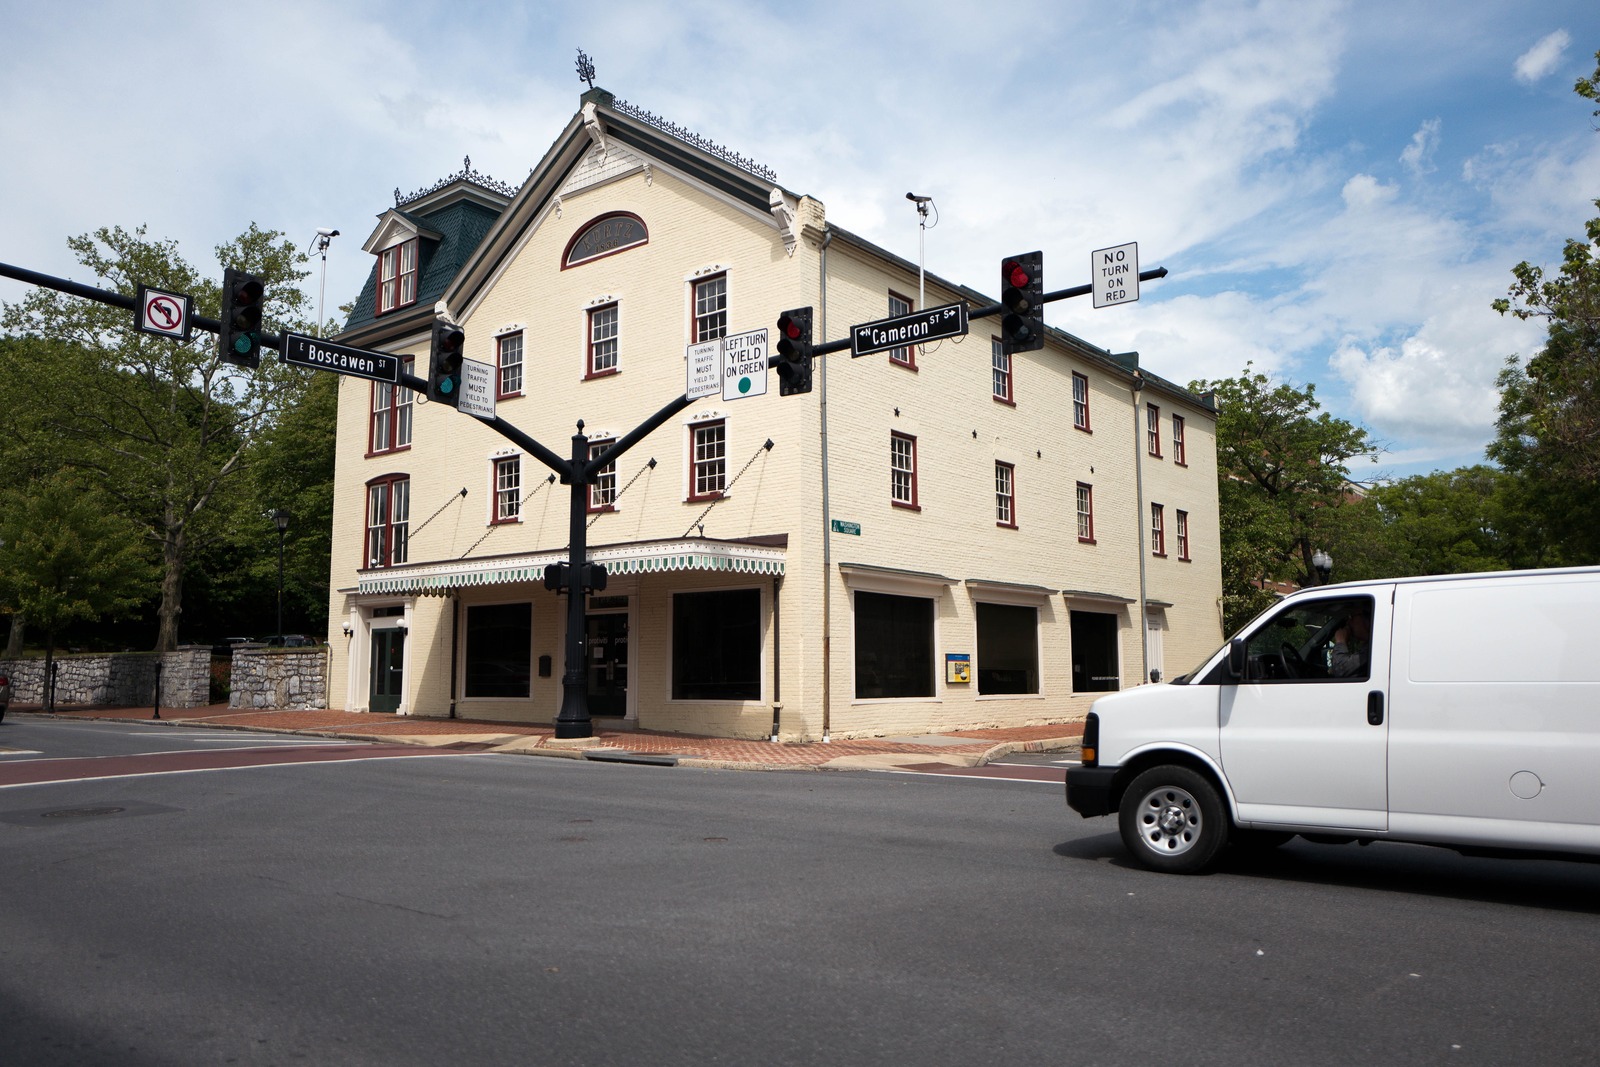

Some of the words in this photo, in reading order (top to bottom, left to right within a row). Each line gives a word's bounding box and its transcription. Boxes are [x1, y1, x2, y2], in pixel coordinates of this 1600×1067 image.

[582, 222, 633, 251] KURTZ
[1104, 250, 1125, 264] NO
[1102, 264, 1128, 277] TURN
[1108, 278, 1123, 288] ON
[1106, 290, 1126, 302] RED
[865, 327, 870, 336] N
[872, 322, 928, 344] Cameron
[930, 314, 940, 324] ST
[944, 310, 949, 319] S
[726, 338, 744, 351] LEFT
[746, 332, 766, 346] TURN
[694, 346, 714, 355] TURNING
[730, 347, 762, 364] YIELD
[300, 342, 304, 351] E
[308, 344, 374, 372] Boscawen
[378, 359, 386, 368] ST
[695, 355, 714, 364] TRAFFIC
[467, 364, 488, 376] TURNING
[696, 364, 712, 374] MUST
[726, 366, 737, 378] ON
[738, 360, 764, 376] GREEN
[467, 374, 488, 384] TRAFFIC
[468, 383, 486, 394] MUST
[688, 382, 720, 394] PEDESTRIANS
[466, 393, 480, 402] YIELD
[460, 400, 493, 414] PEDESTRIANS
